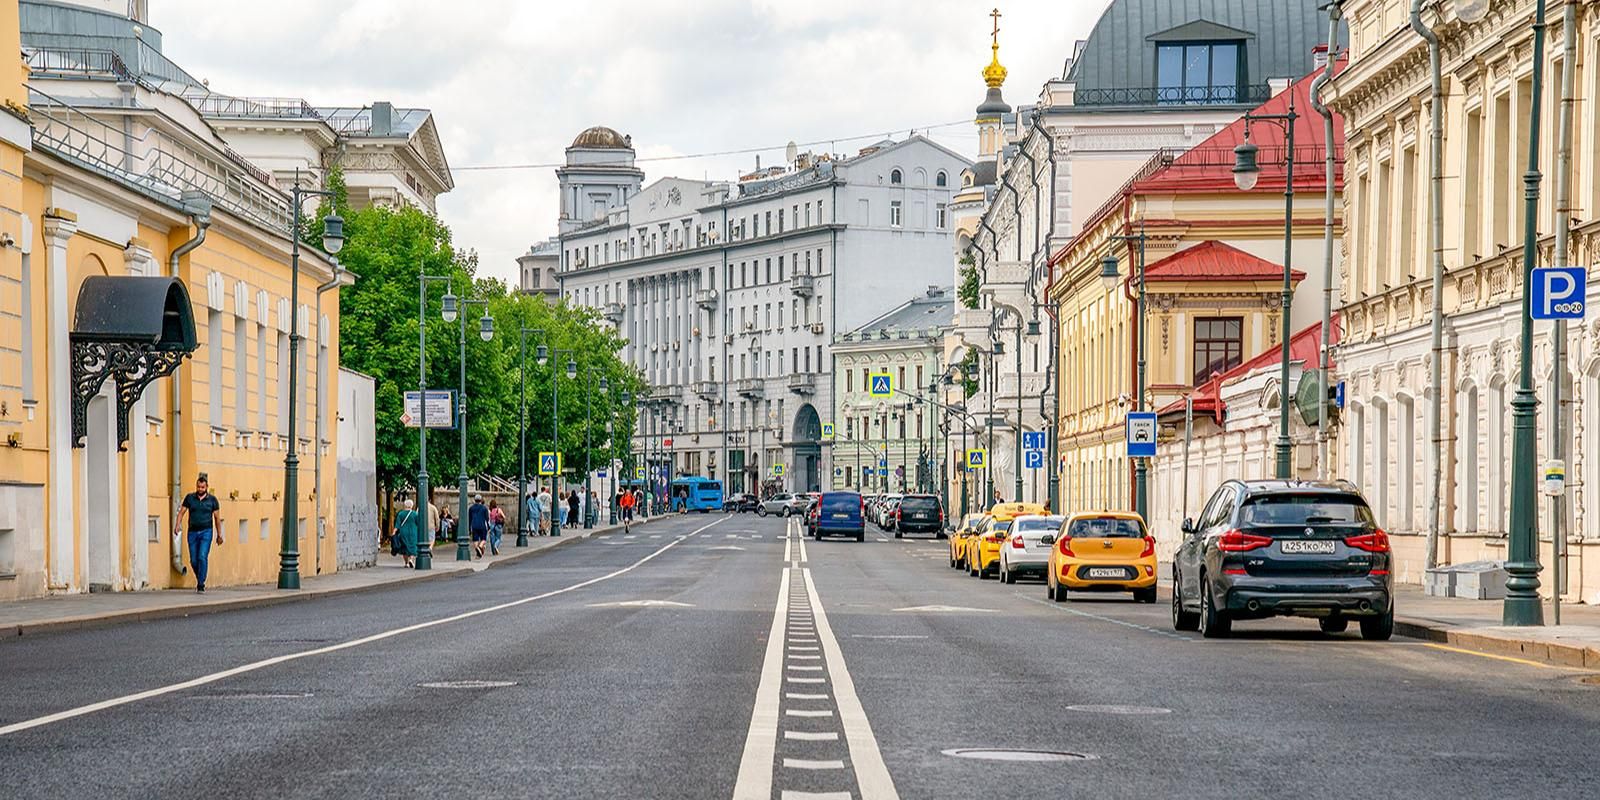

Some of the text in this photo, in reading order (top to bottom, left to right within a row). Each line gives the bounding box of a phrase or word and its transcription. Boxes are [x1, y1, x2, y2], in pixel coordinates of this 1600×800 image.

[1544, 271, 1576, 315] P
[1571, 303, 1582, 312] 20
[1029, 452, 1040, 467] P
